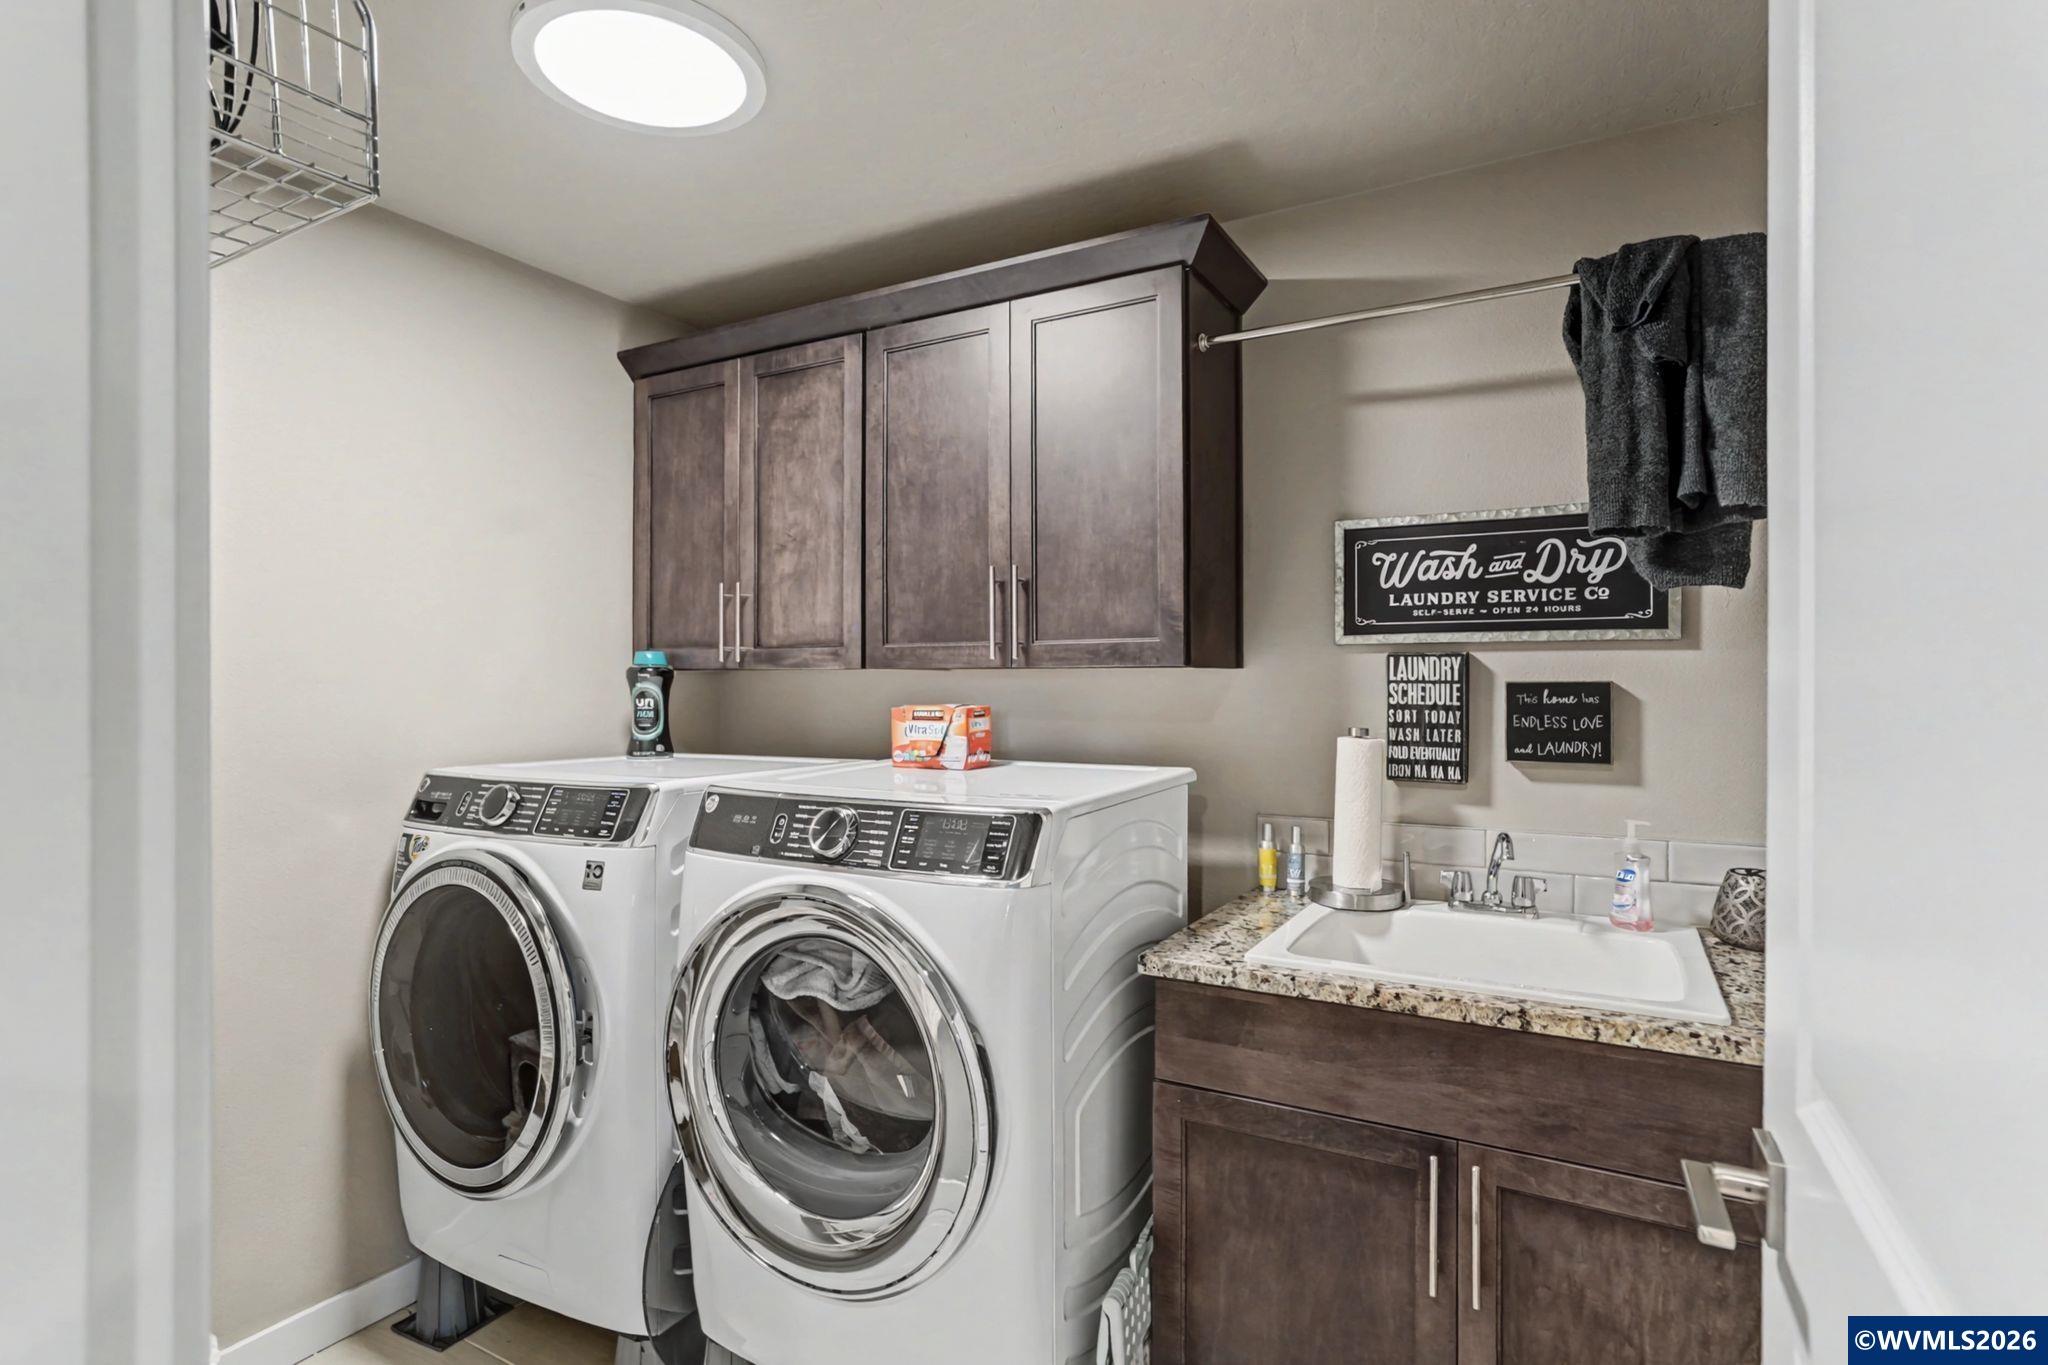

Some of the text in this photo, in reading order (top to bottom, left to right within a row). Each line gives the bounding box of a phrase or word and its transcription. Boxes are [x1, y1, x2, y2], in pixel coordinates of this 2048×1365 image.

[1371, 537, 1628, 589] Wash and Dry
[1388, 590, 1481, 607] LAUNDRY
[1487, 587, 1577, 604] SERVICE
[1412, 604, 1582, 617] SELF-SERVE OPEN 24 HOURS
[1388, 656, 1462, 682] LAUNDRY
[1388, 682, 1461, 706] SCHEDULE
[1516, 688, 1600, 705] This home has
[1388, 709, 1461, 725] SORT TODAY
[1512, 714, 1604, 731] ENDLESS LOVE
[1388, 727, 1462, 743] WASH LATER
[1388, 745, 1461, 761] FOLD EVENTUALLY
[1513, 741, 1602, 759] and LAUNDRY!
[1388, 763, 1411, 778] IRON
